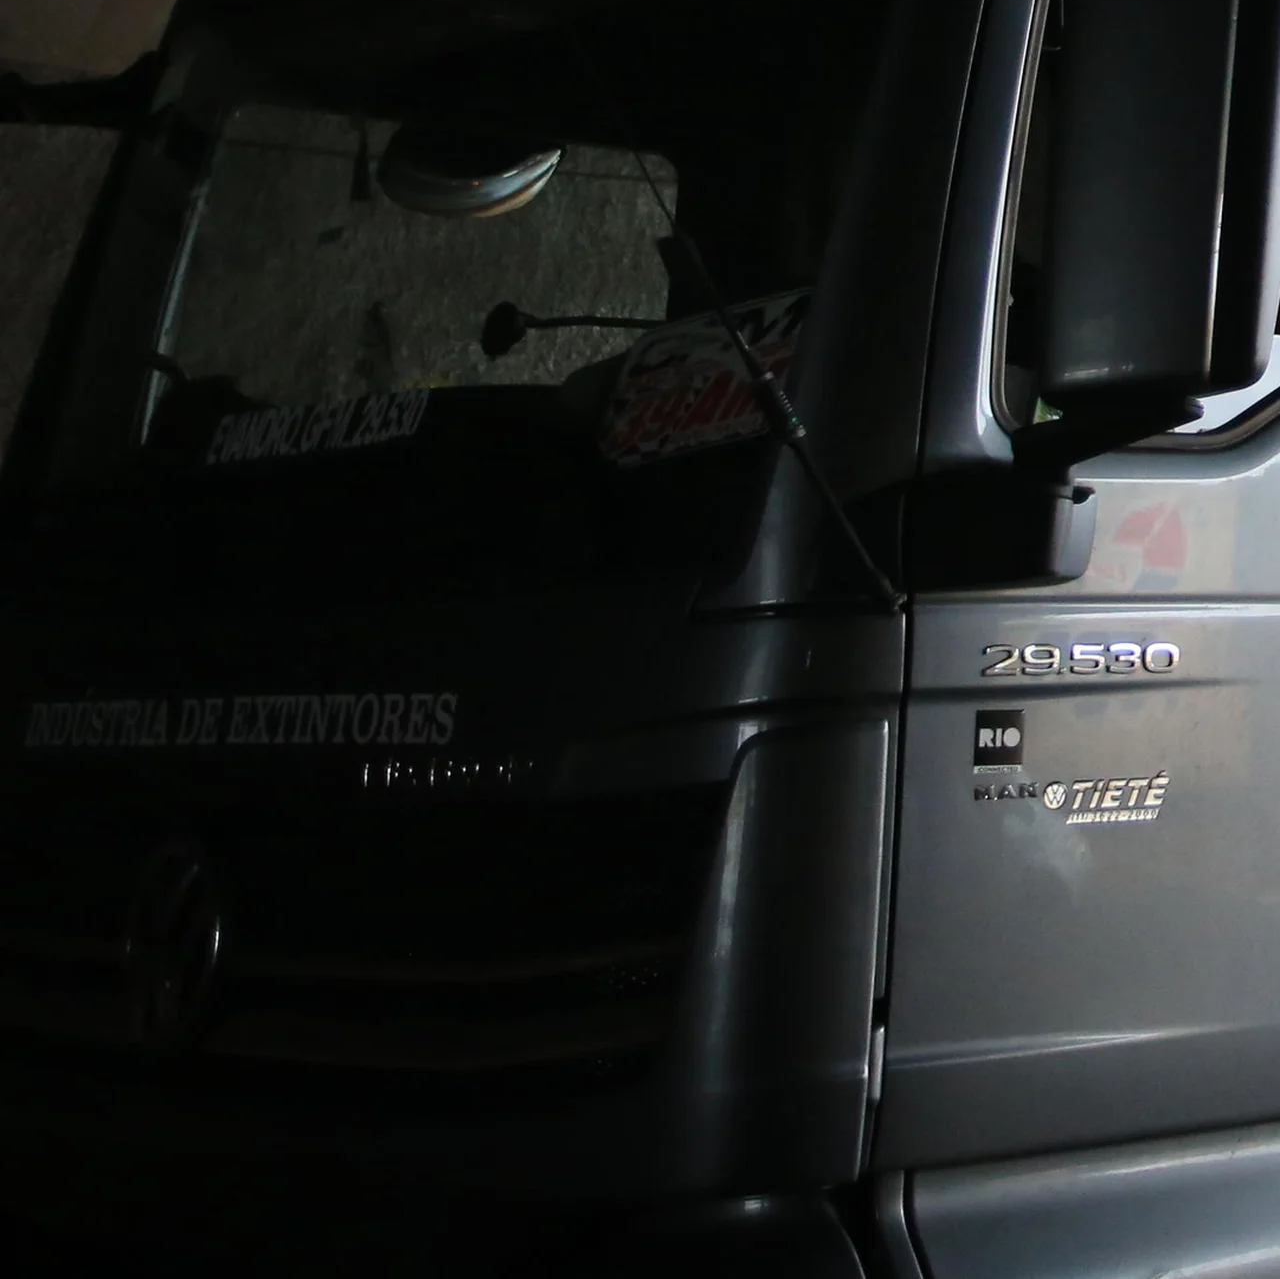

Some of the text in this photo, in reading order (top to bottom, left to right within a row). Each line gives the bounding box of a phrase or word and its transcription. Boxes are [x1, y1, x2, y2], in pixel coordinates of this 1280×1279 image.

[981, 641, 1181, 677] 29.530
[24, 687, 459, 748] INDÚSTRIA DE EXTINTORES
[978, 727, 1022, 748] RIO
[973, 782, 1039, 802] MAN
